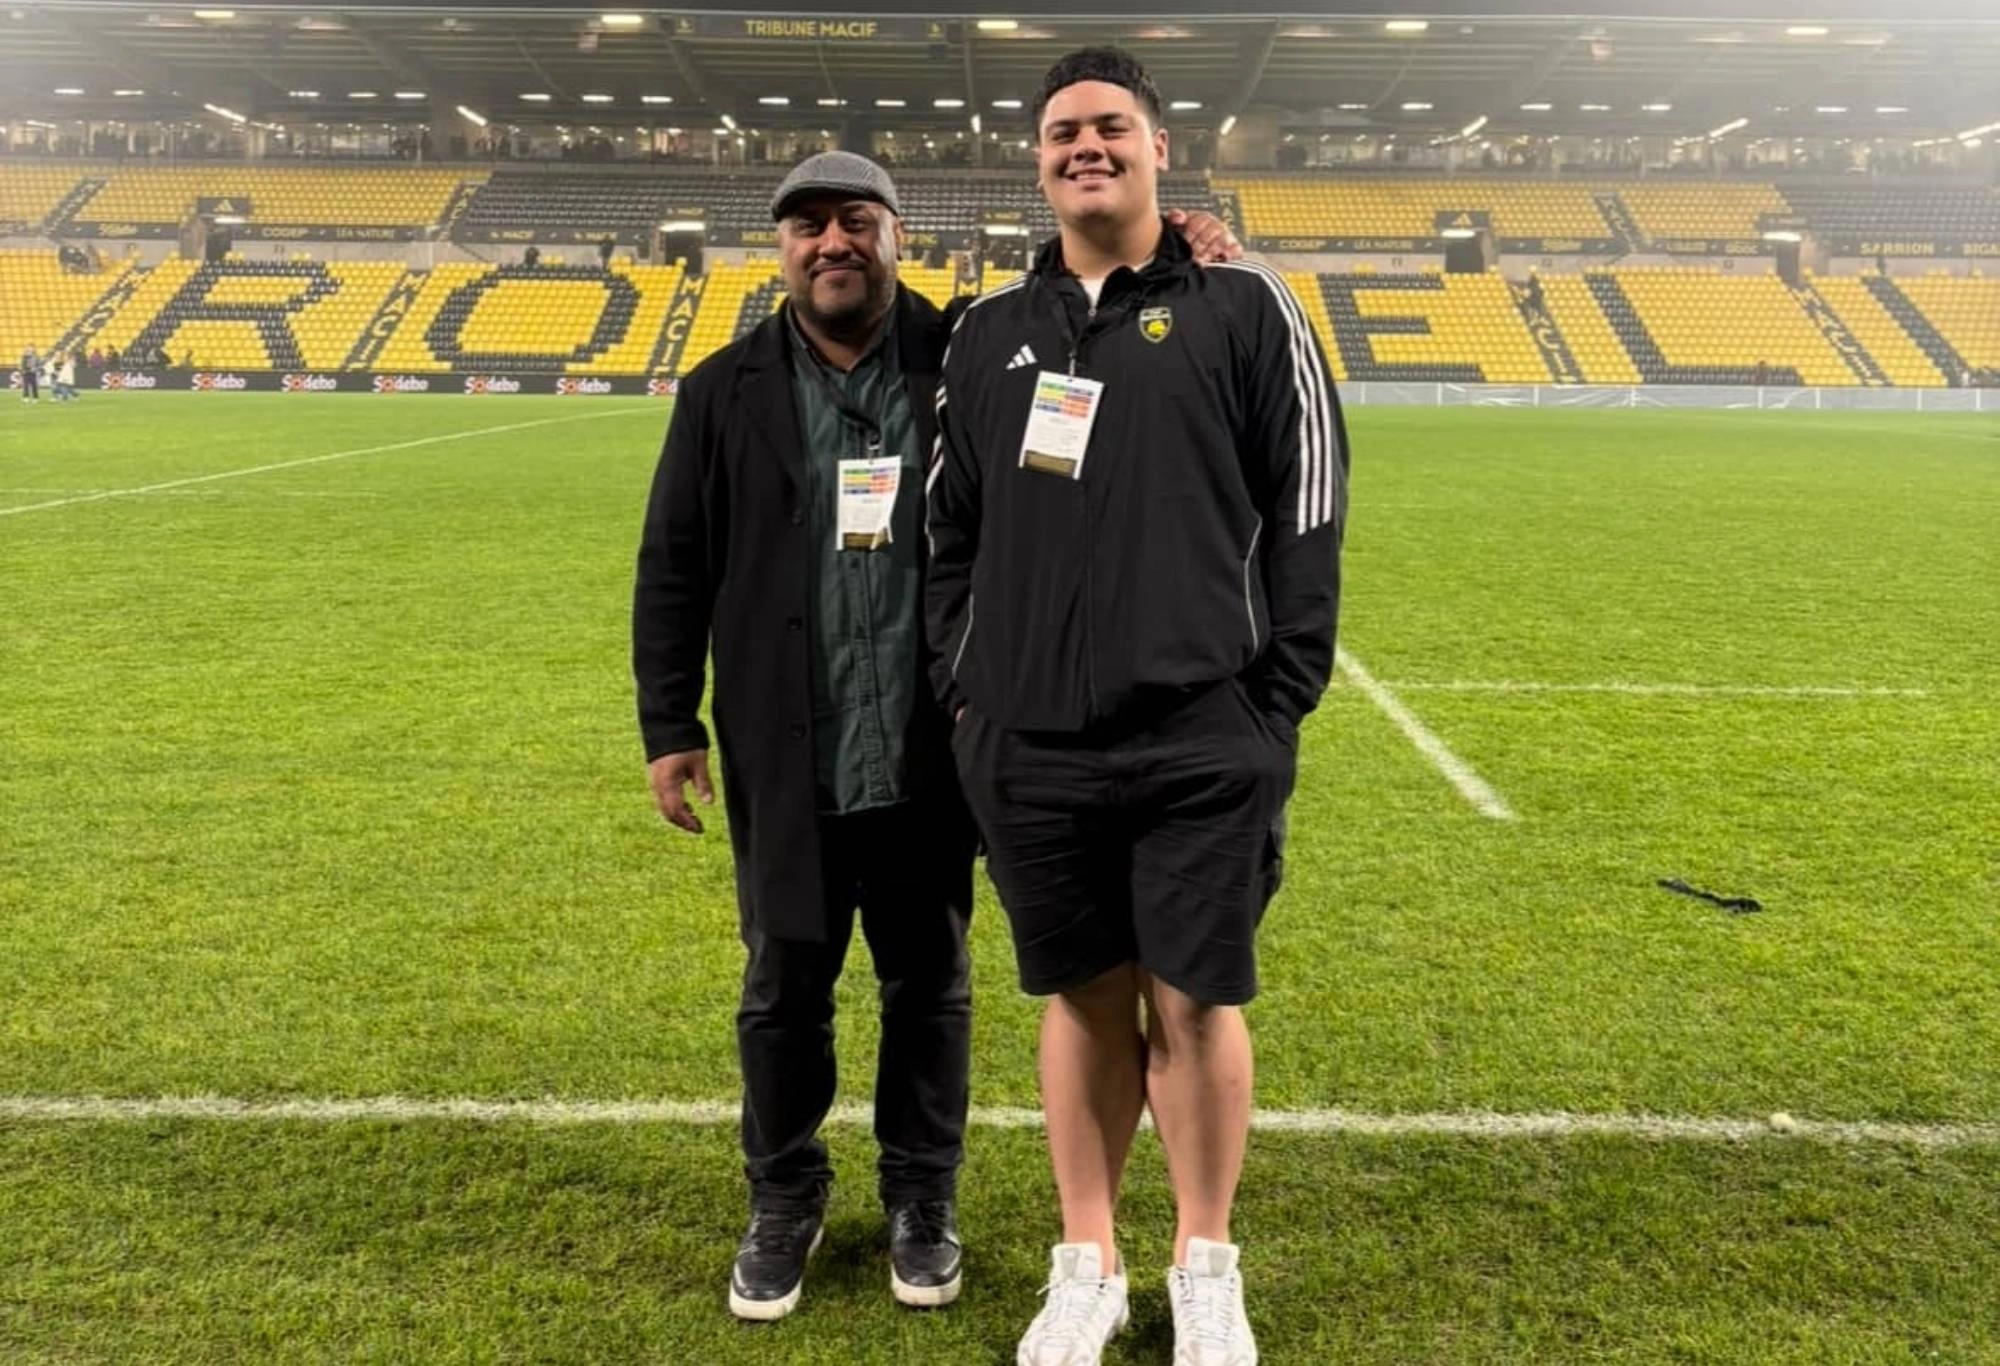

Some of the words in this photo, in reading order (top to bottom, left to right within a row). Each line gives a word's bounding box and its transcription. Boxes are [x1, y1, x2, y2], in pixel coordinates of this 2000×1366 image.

[745, 20, 815, 36] TRIBUNE
[820, 21, 877, 37] MACIF
[647, 378, 678, 396] Sod
